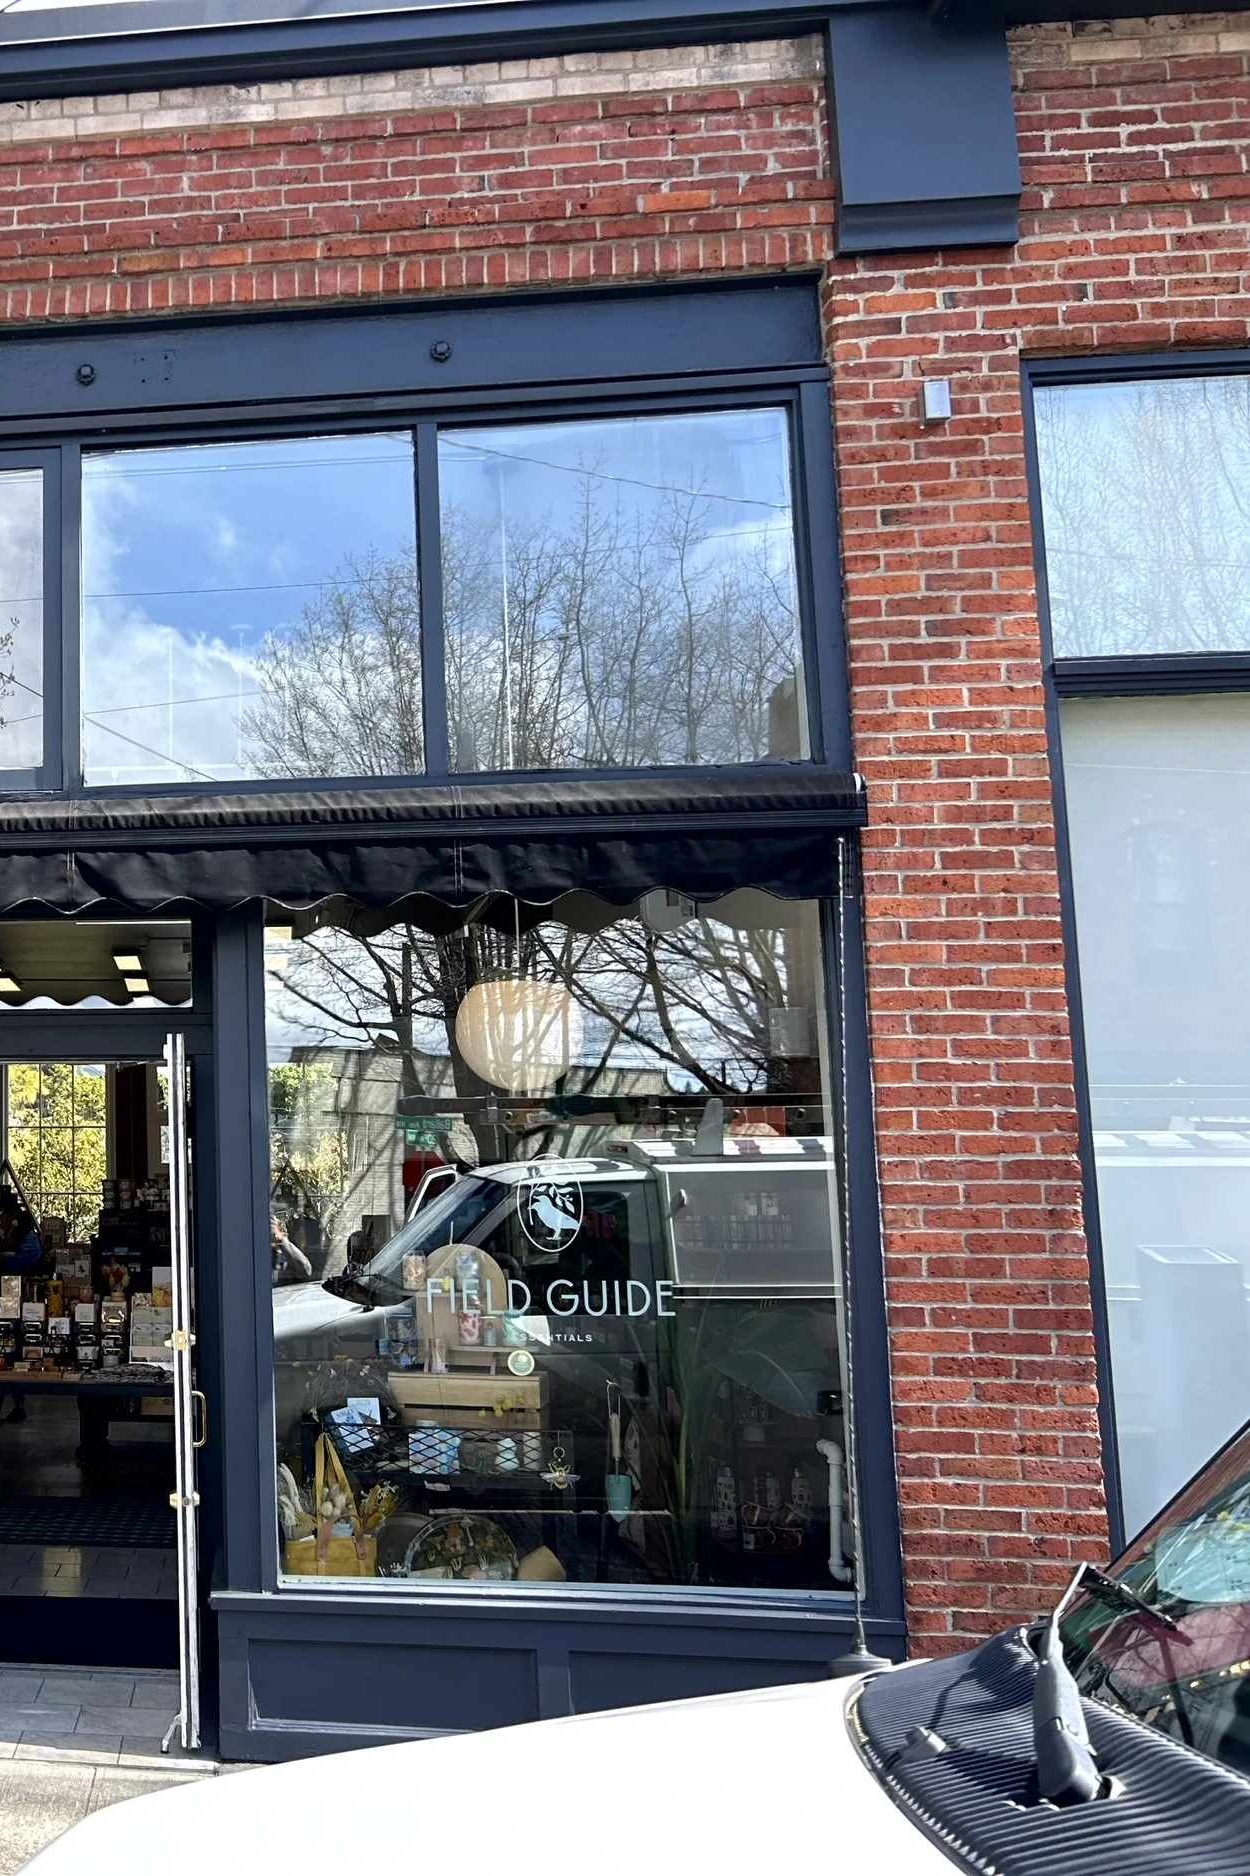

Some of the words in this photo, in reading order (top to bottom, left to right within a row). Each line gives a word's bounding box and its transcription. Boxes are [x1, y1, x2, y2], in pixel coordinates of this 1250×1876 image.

[426, 1278, 531, 1315] FIELD
[546, 1279, 676, 1317] GUIDE
[513, 1332, 593, 1342] SSNTIALS
